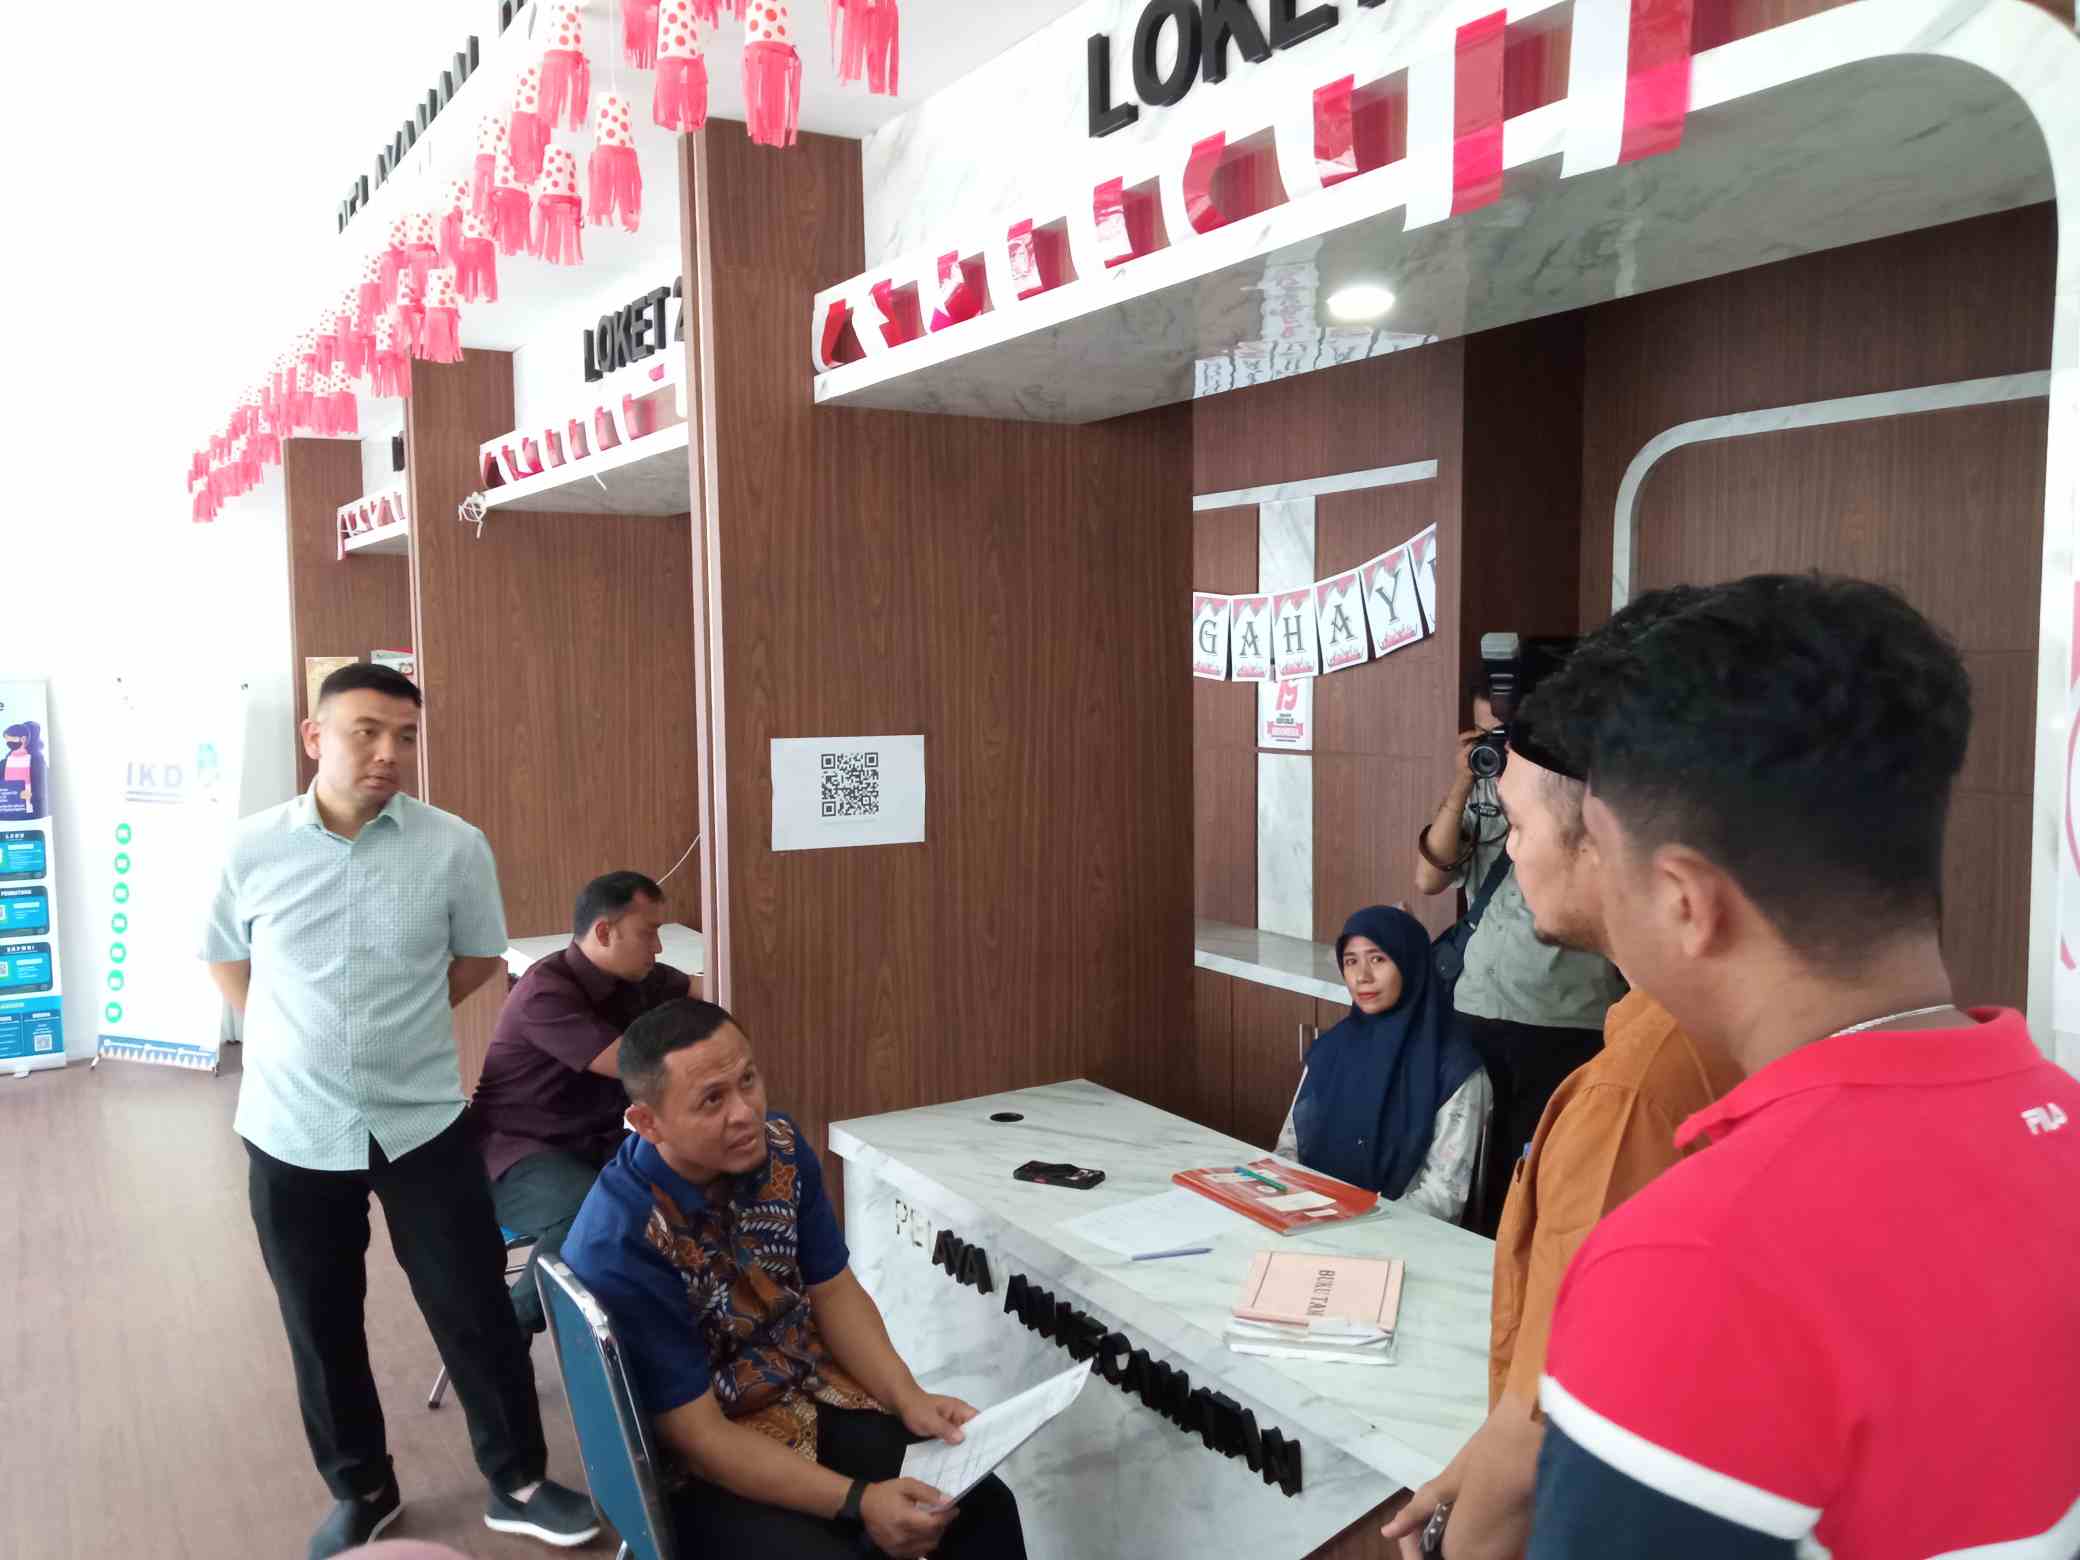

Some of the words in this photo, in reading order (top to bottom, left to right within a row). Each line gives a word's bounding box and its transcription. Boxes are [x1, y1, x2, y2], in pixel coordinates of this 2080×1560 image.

[1087, 0, 1387, 138] LOK
[583, 285, 671, 383] LOKET
[1198, 558, 1437, 658] GAHAY
